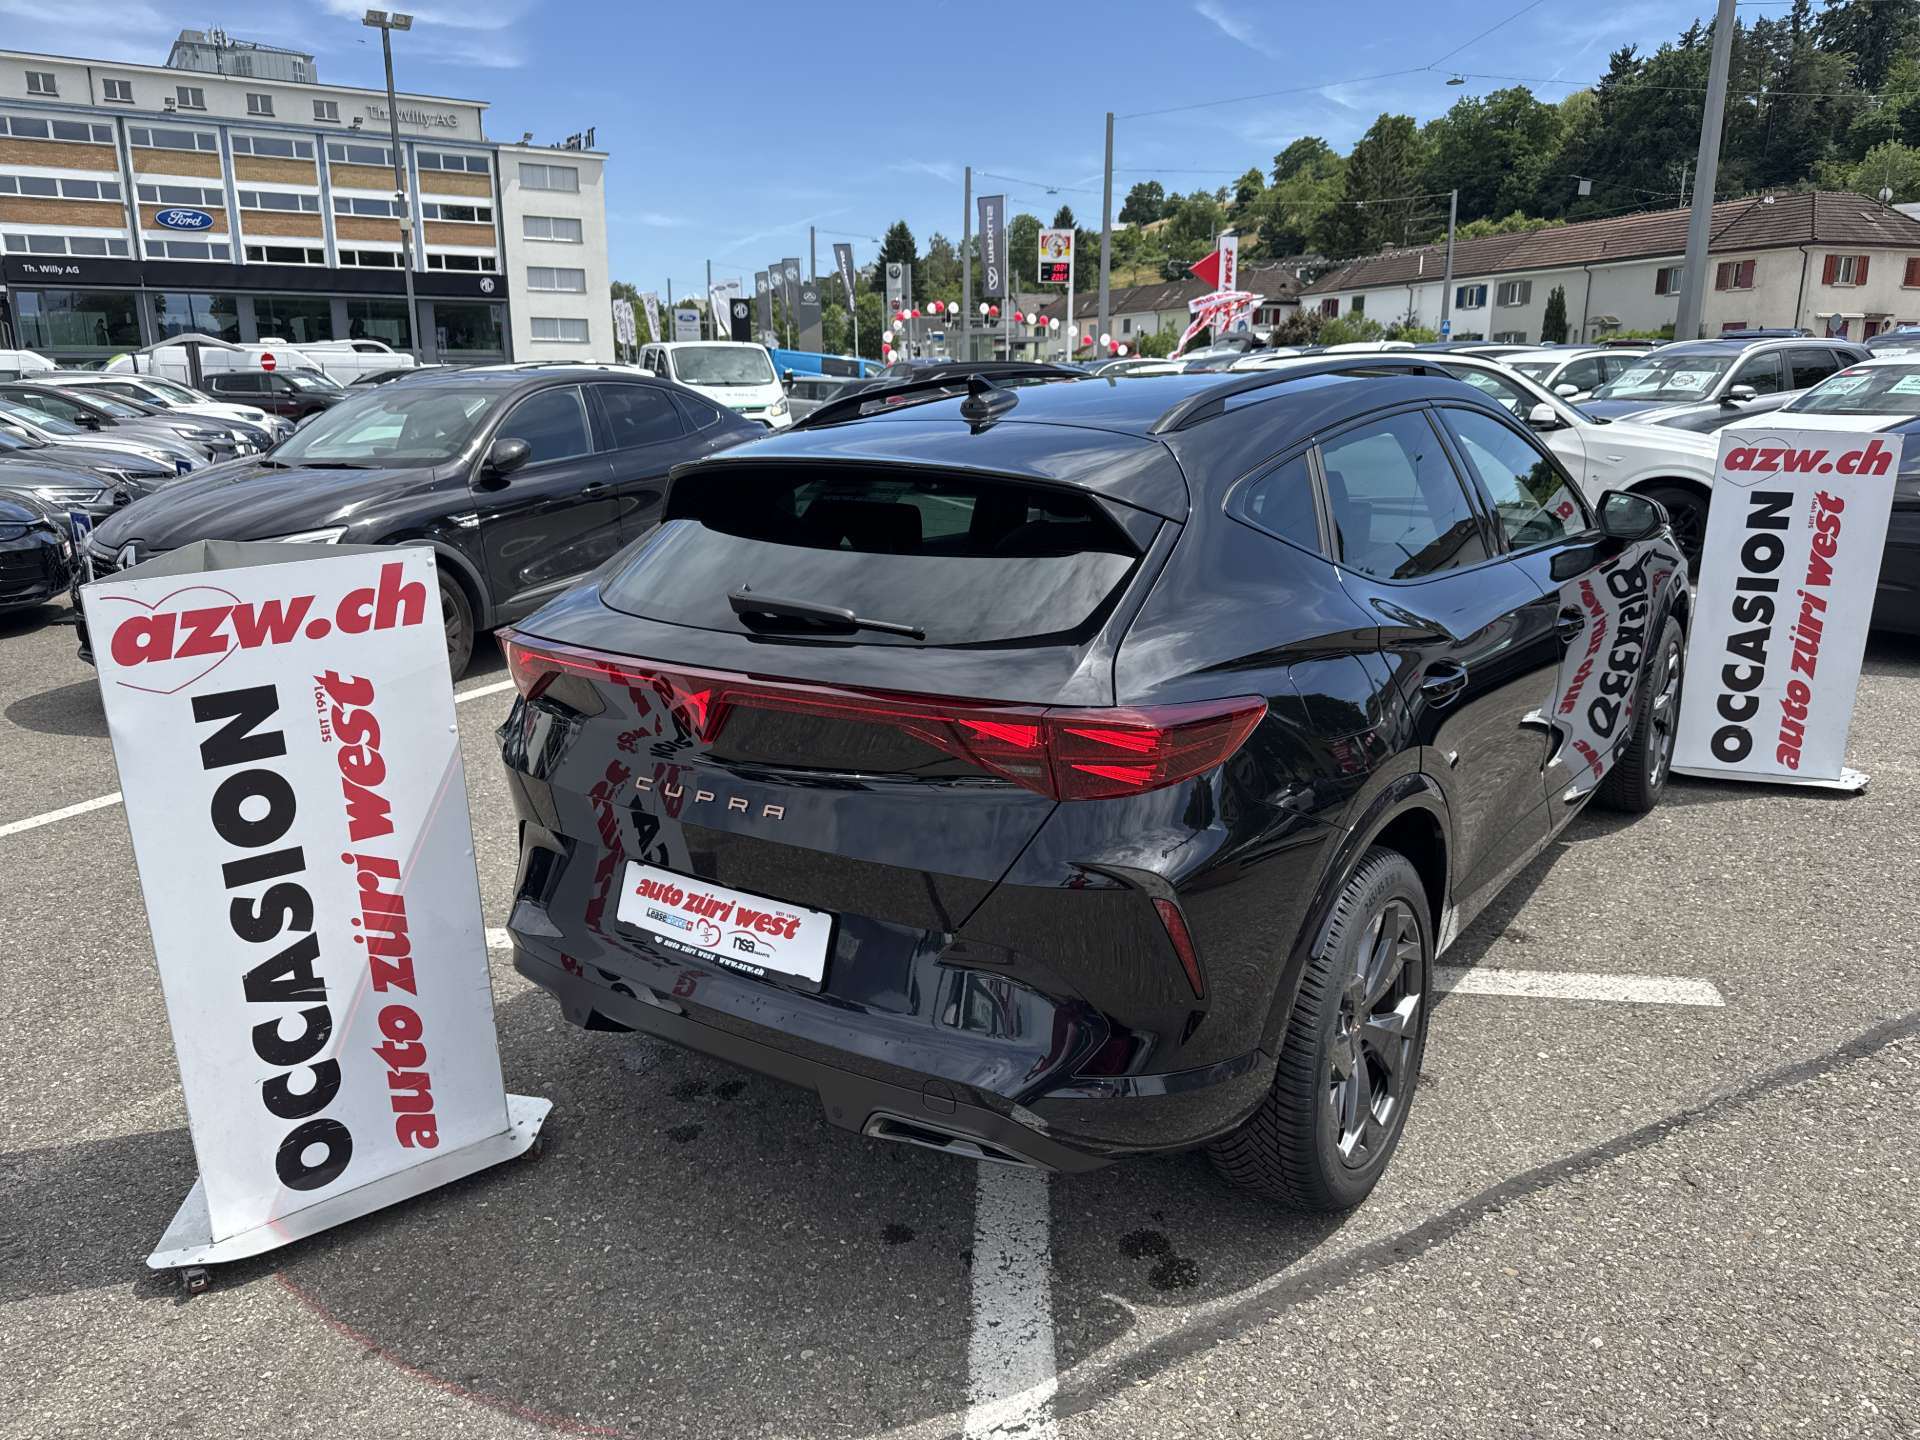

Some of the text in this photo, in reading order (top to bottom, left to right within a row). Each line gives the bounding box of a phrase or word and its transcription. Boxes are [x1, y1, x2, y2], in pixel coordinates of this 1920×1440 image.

[396, 108, 431, 129] Willy
[435, 112, 459, 128] AG
[167, 210, 202, 227] Ford
[22, 264, 80, 276] Th. Willy AG
[480, 277, 495, 293] MG
[1724, 439, 1893, 476] azw.ch
[110, 561, 428, 667] azw.ch
[1710, 490, 1795, 763] OCCASION
[1775, 489, 1845, 770] auto züri west
[313, 685, 332, 743] SEIT 1991
[635, 776, 785, 821] CUPRA
[312, 669, 440, 1149] auto züri west
[635, 877, 802, 940] auto züri west
[190, 684, 354, 1192] OCCASION
[663, 939, 680, 950] auto
[698, 948, 716, 961] west
[733, 936, 755, 953] nsa
